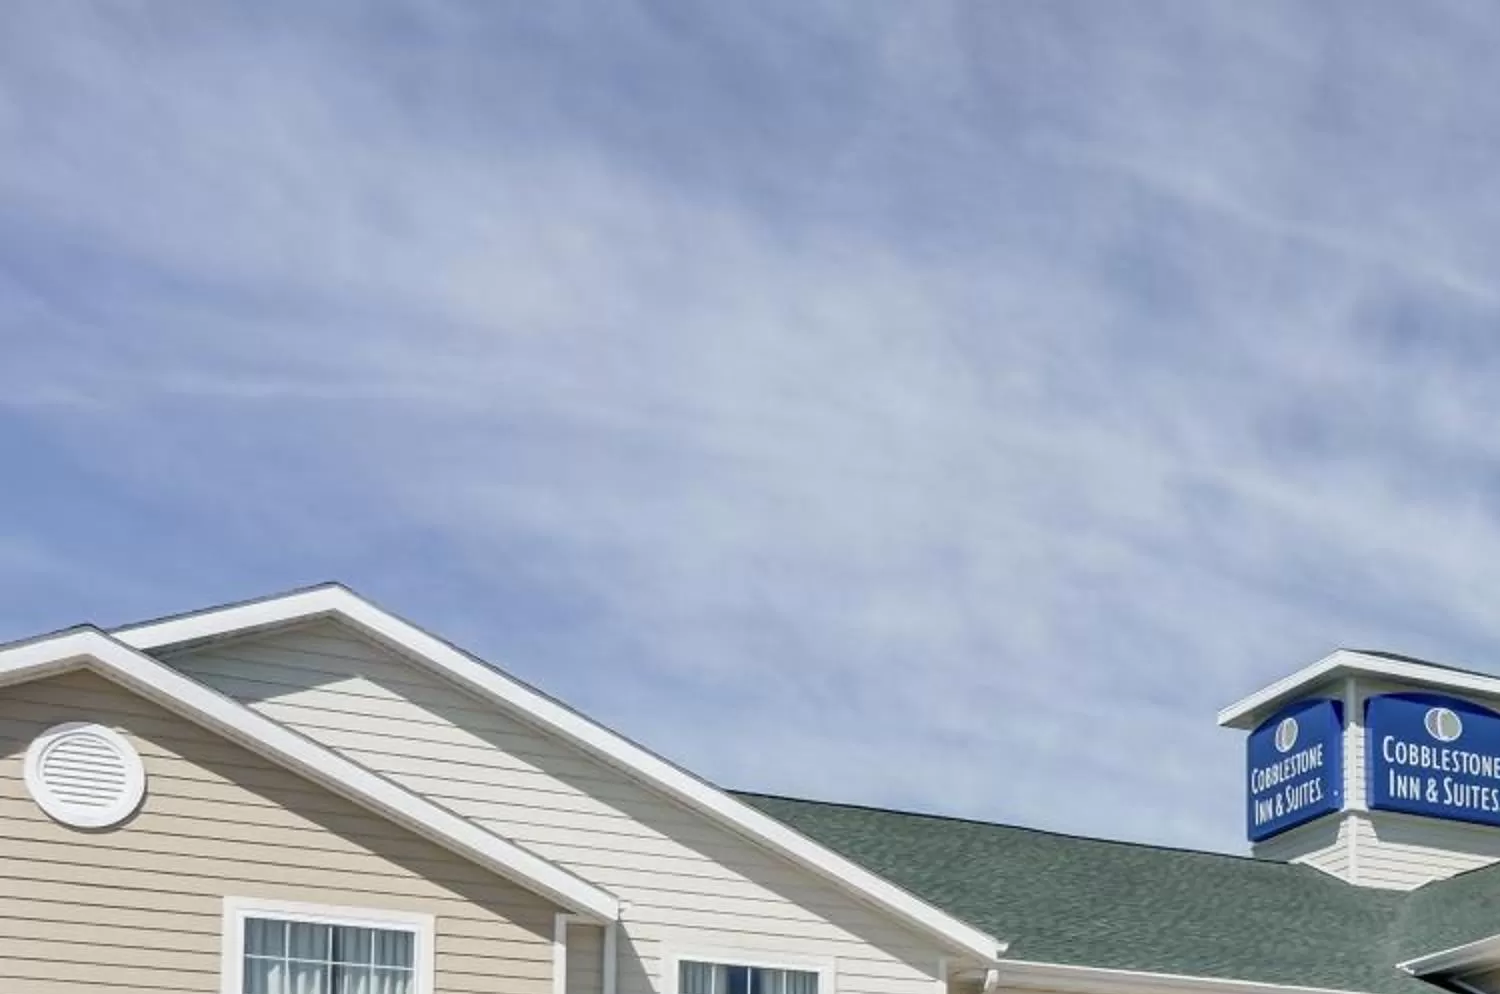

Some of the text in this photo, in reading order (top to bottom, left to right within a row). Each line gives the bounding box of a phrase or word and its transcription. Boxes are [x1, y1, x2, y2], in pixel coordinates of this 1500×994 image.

[1252, 743, 1323, 794] COBBLESTONE
[1389, 768, 1421, 801] INN
[1425, 777, 1439, 803] &
[1255, 798, 1273, 826] INN
[1276, 793, 1284, 817] &
